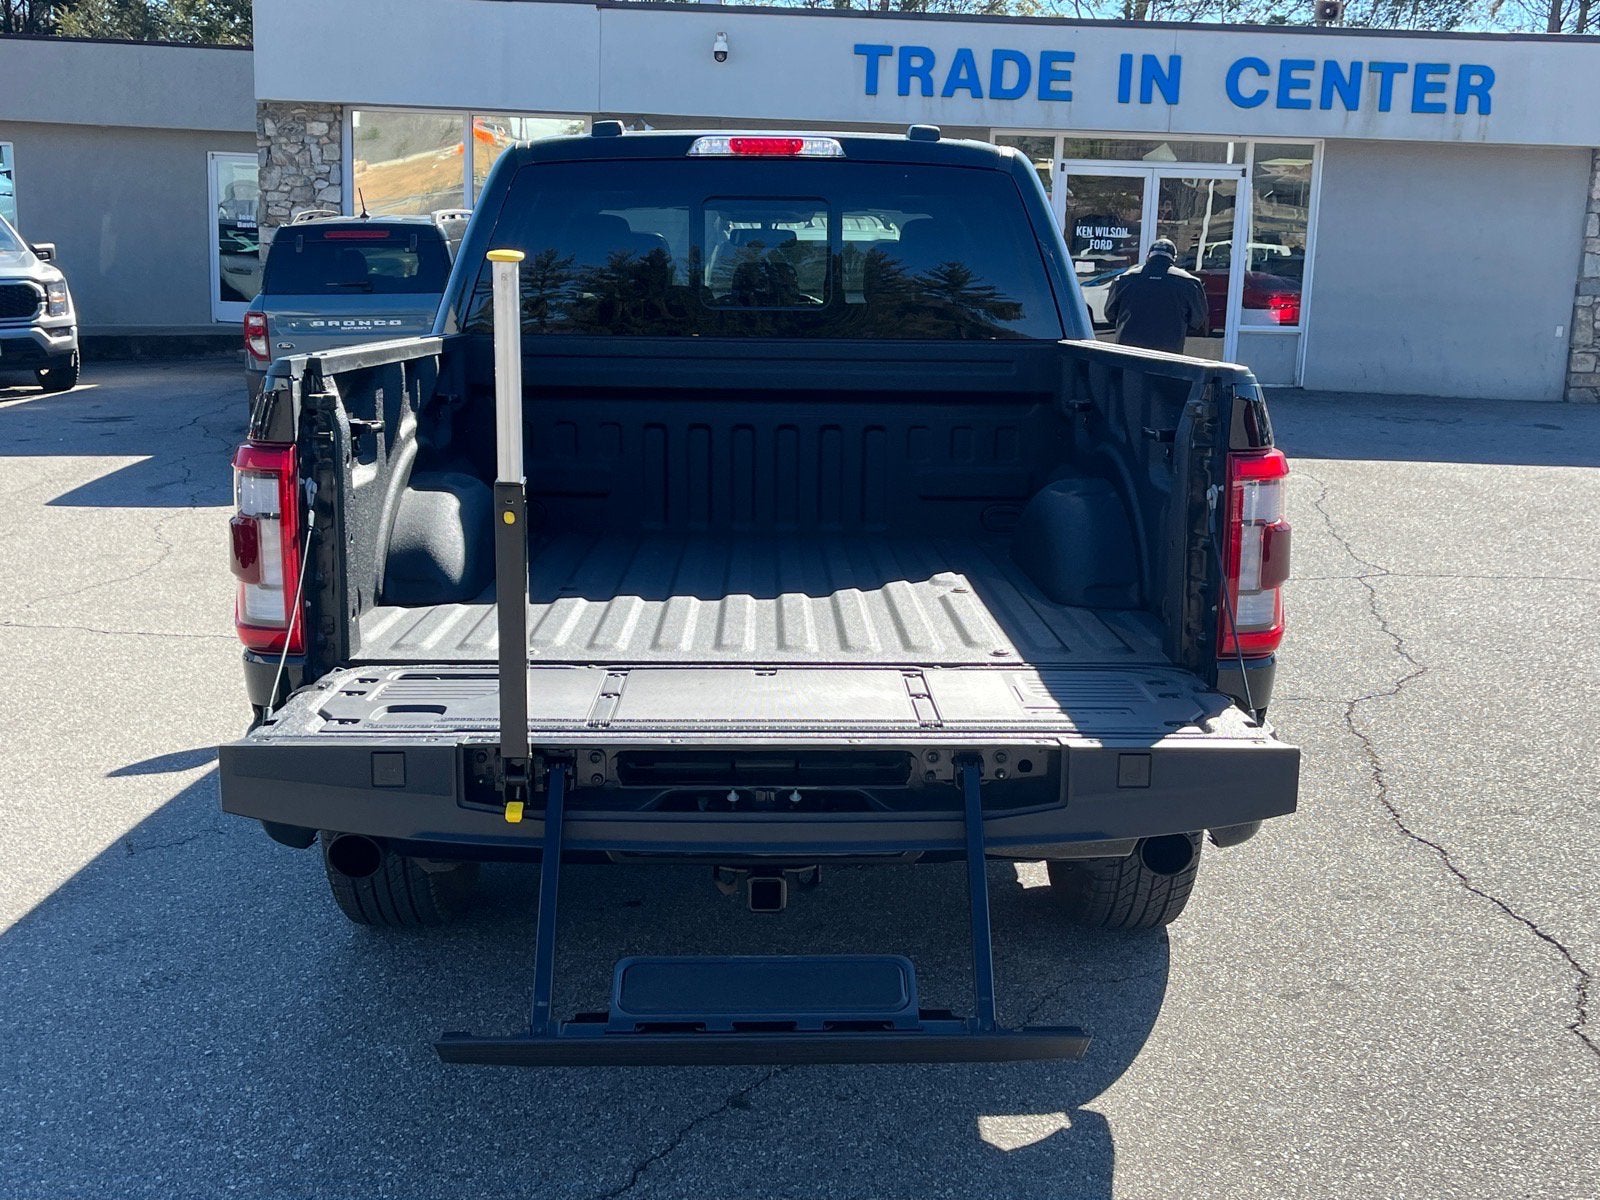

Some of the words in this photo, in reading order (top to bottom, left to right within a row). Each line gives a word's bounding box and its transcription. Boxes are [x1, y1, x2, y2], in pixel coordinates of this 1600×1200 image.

[853, 44, 1075, 101] TRADE
[1117, 53, 1182, 105] IN
[1225, 56, 1496, 115] CENTER
[1076, 226, 1093, 237] KEN
[1095, 226, 1128, 237] WILSON
[1090, 239, 1113, 250] FORD
